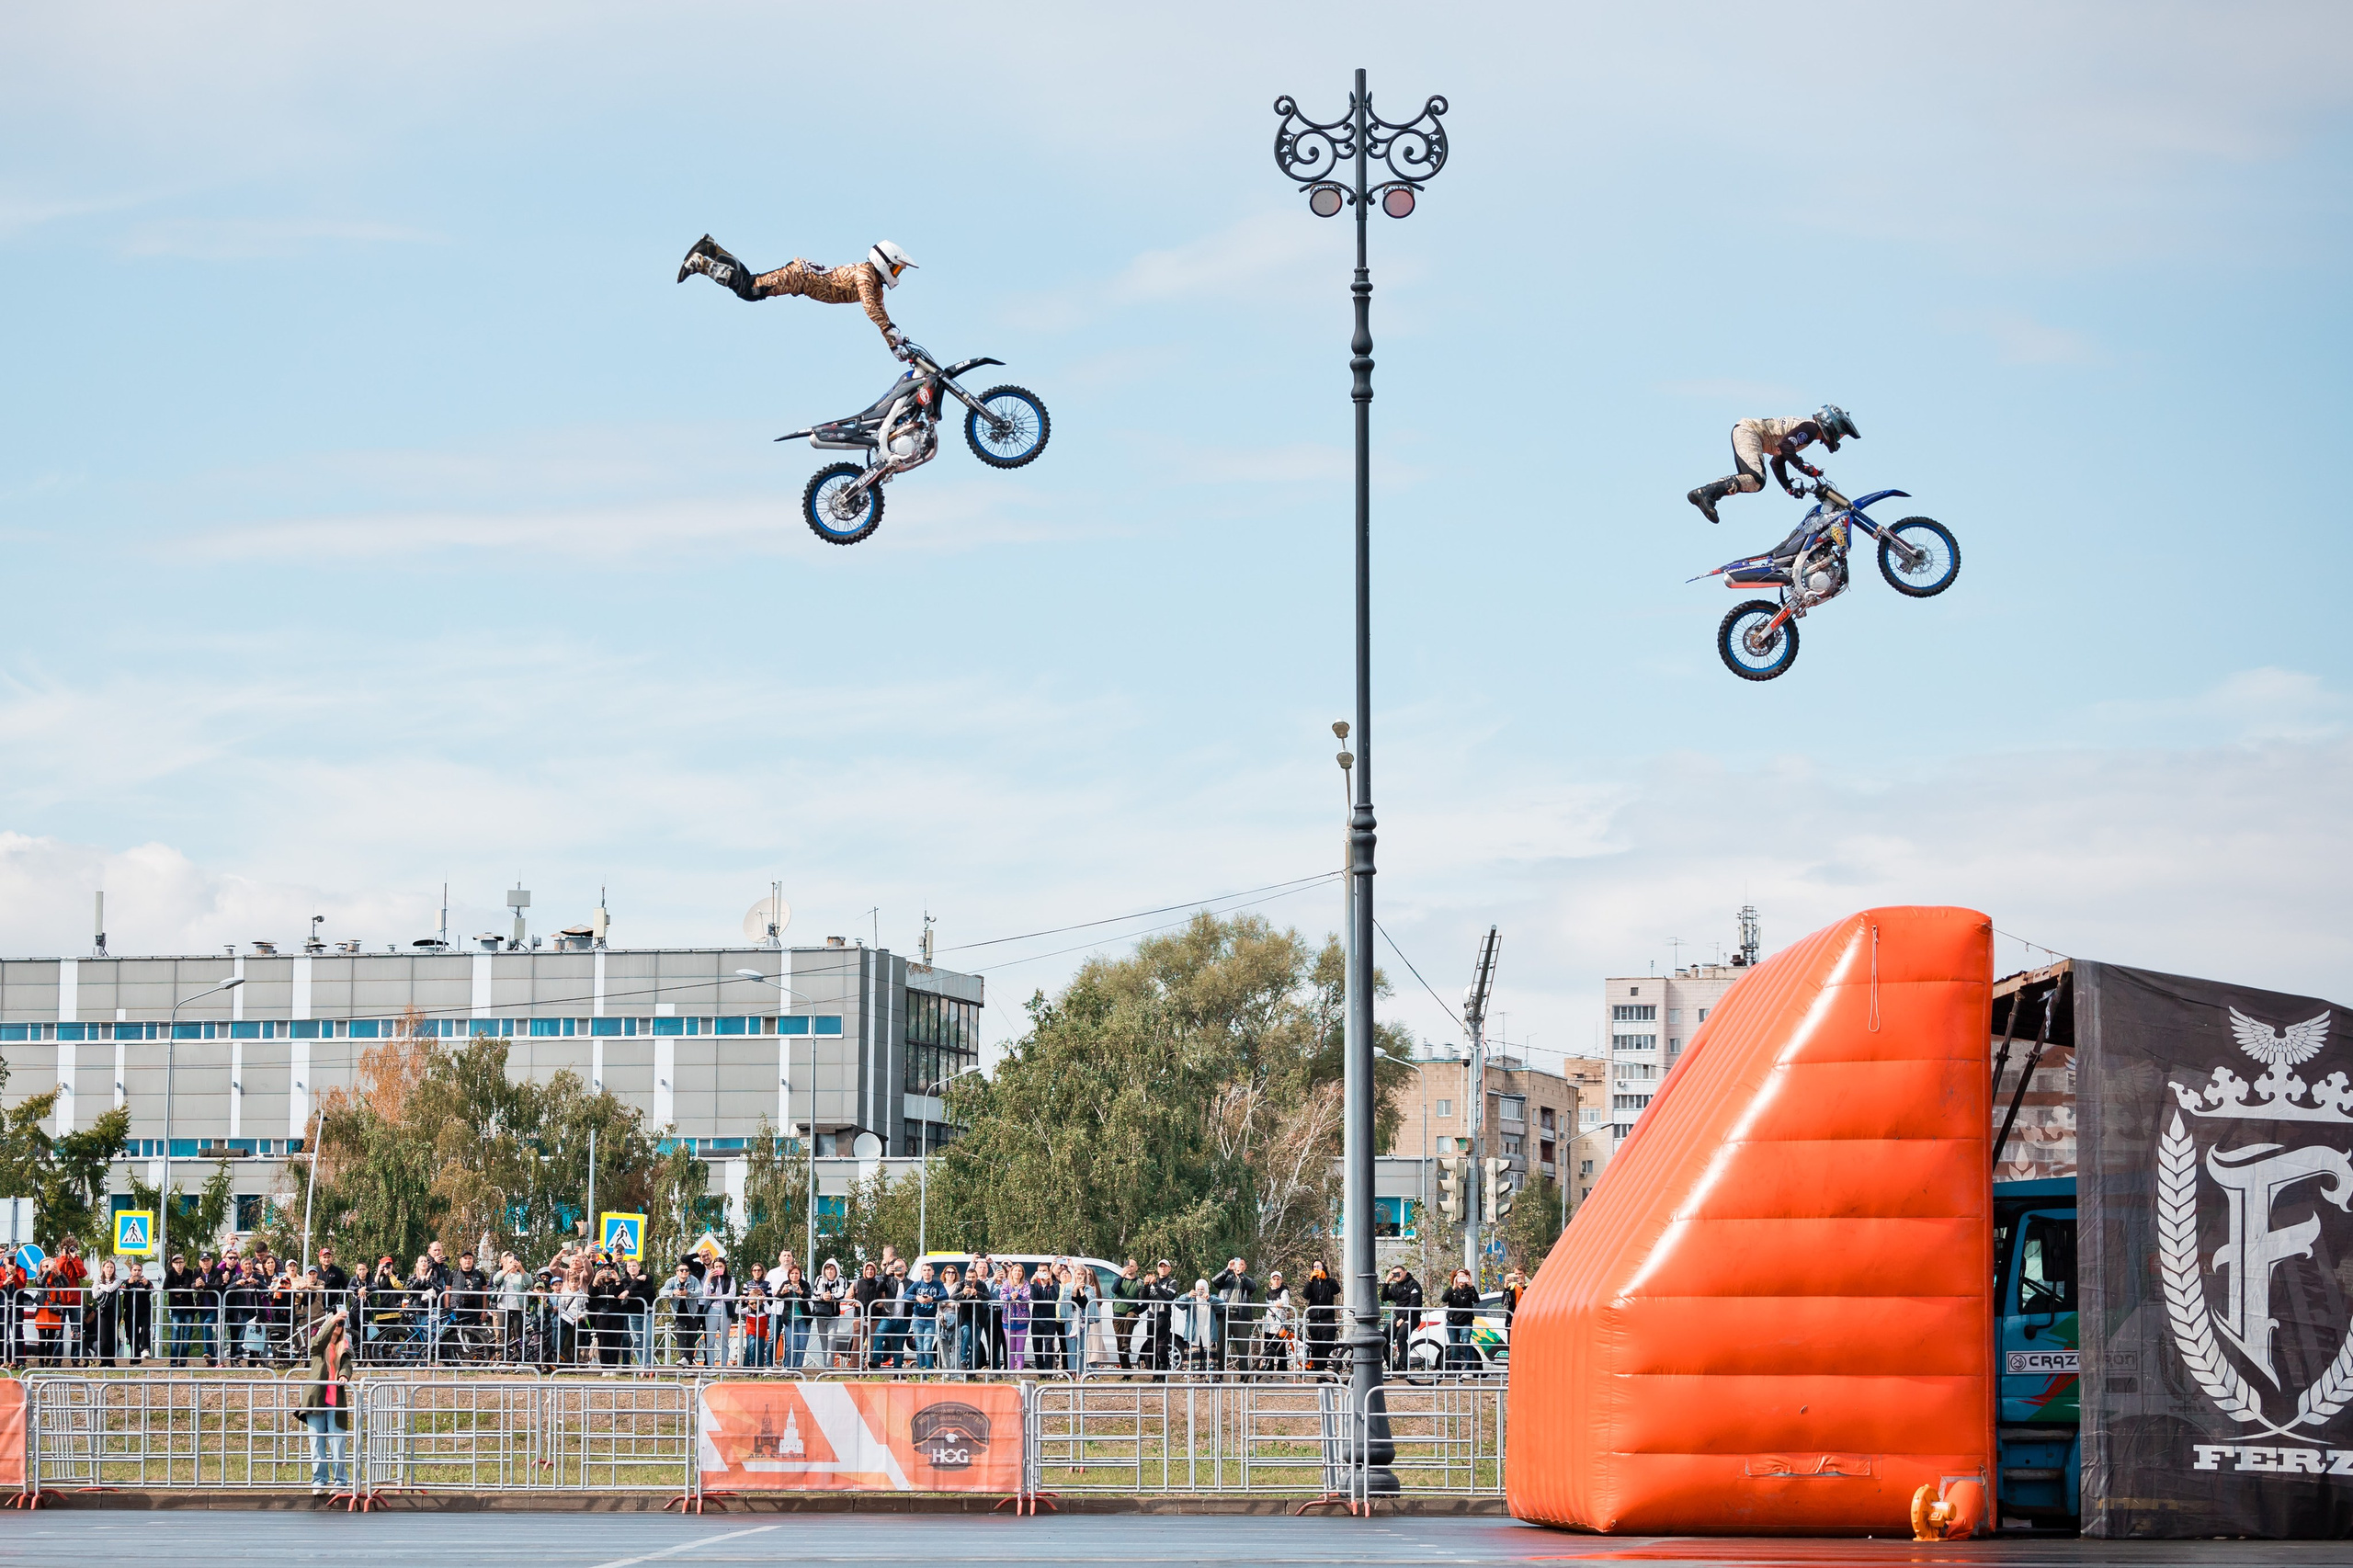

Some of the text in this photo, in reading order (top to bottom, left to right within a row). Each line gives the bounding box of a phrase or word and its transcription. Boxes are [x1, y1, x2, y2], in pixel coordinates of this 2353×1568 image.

[857, 467, 878, 488] KENDA
[1770, 608, 1791, 631] KENDA
[918, 1408, 984, 1426] RED SQUARE CHAPTER
[932, 1448, 969, 1463] HOG
